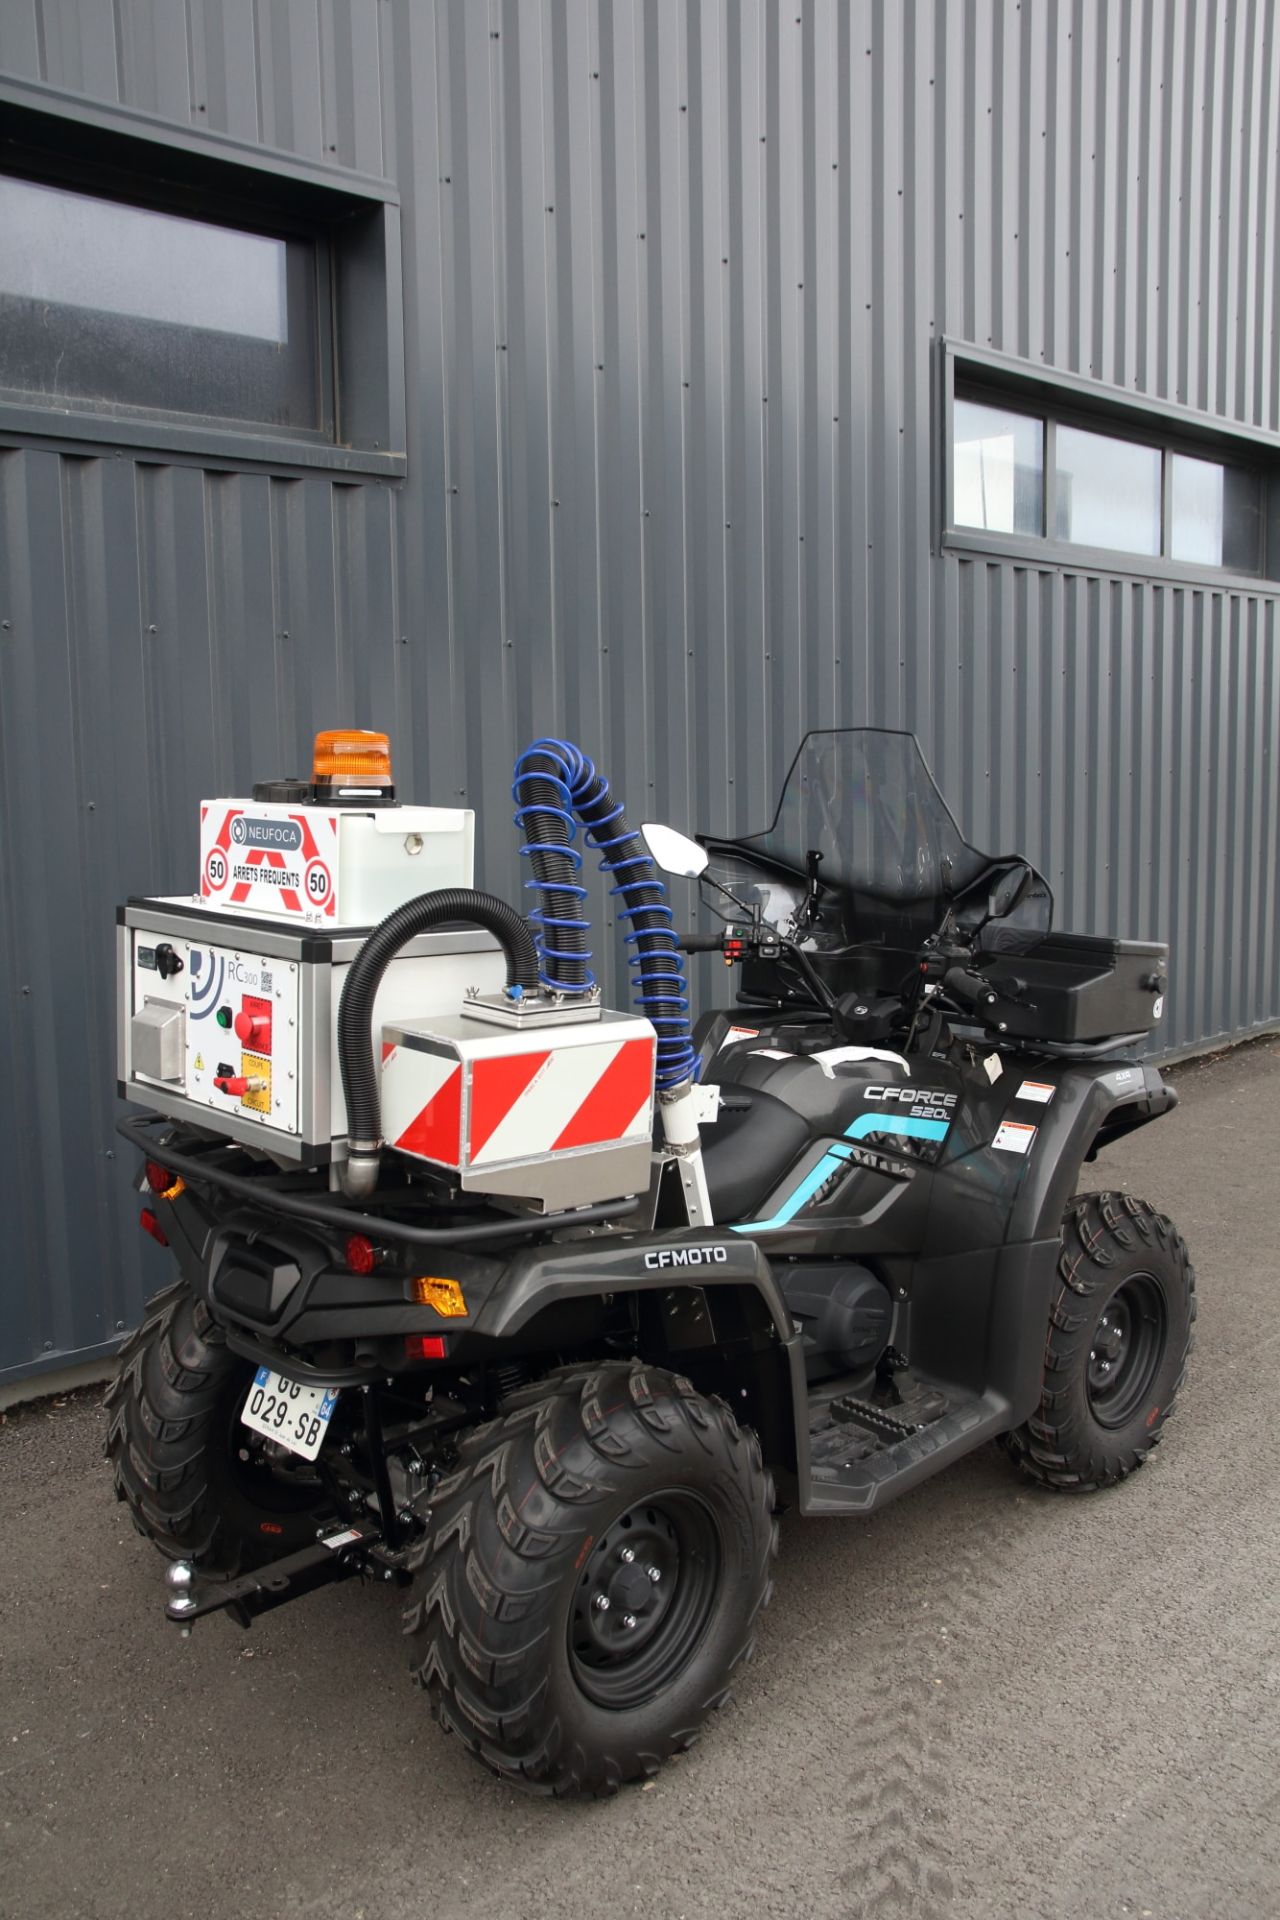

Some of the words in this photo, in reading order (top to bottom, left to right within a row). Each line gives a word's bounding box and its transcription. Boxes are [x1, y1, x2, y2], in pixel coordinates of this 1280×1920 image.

[248, 826, 297, 843] NEUFOCA
[210, 860, 224, 879] 50
[233, 865, 258, 882] ARRETS
[259, 868, 300, 888] FREQUENTS
[310, 872, 326, 894] 50
[863, 1086, 958, 1107] CFORCE
[644, 1246, 727, 1269] CFMOTO
